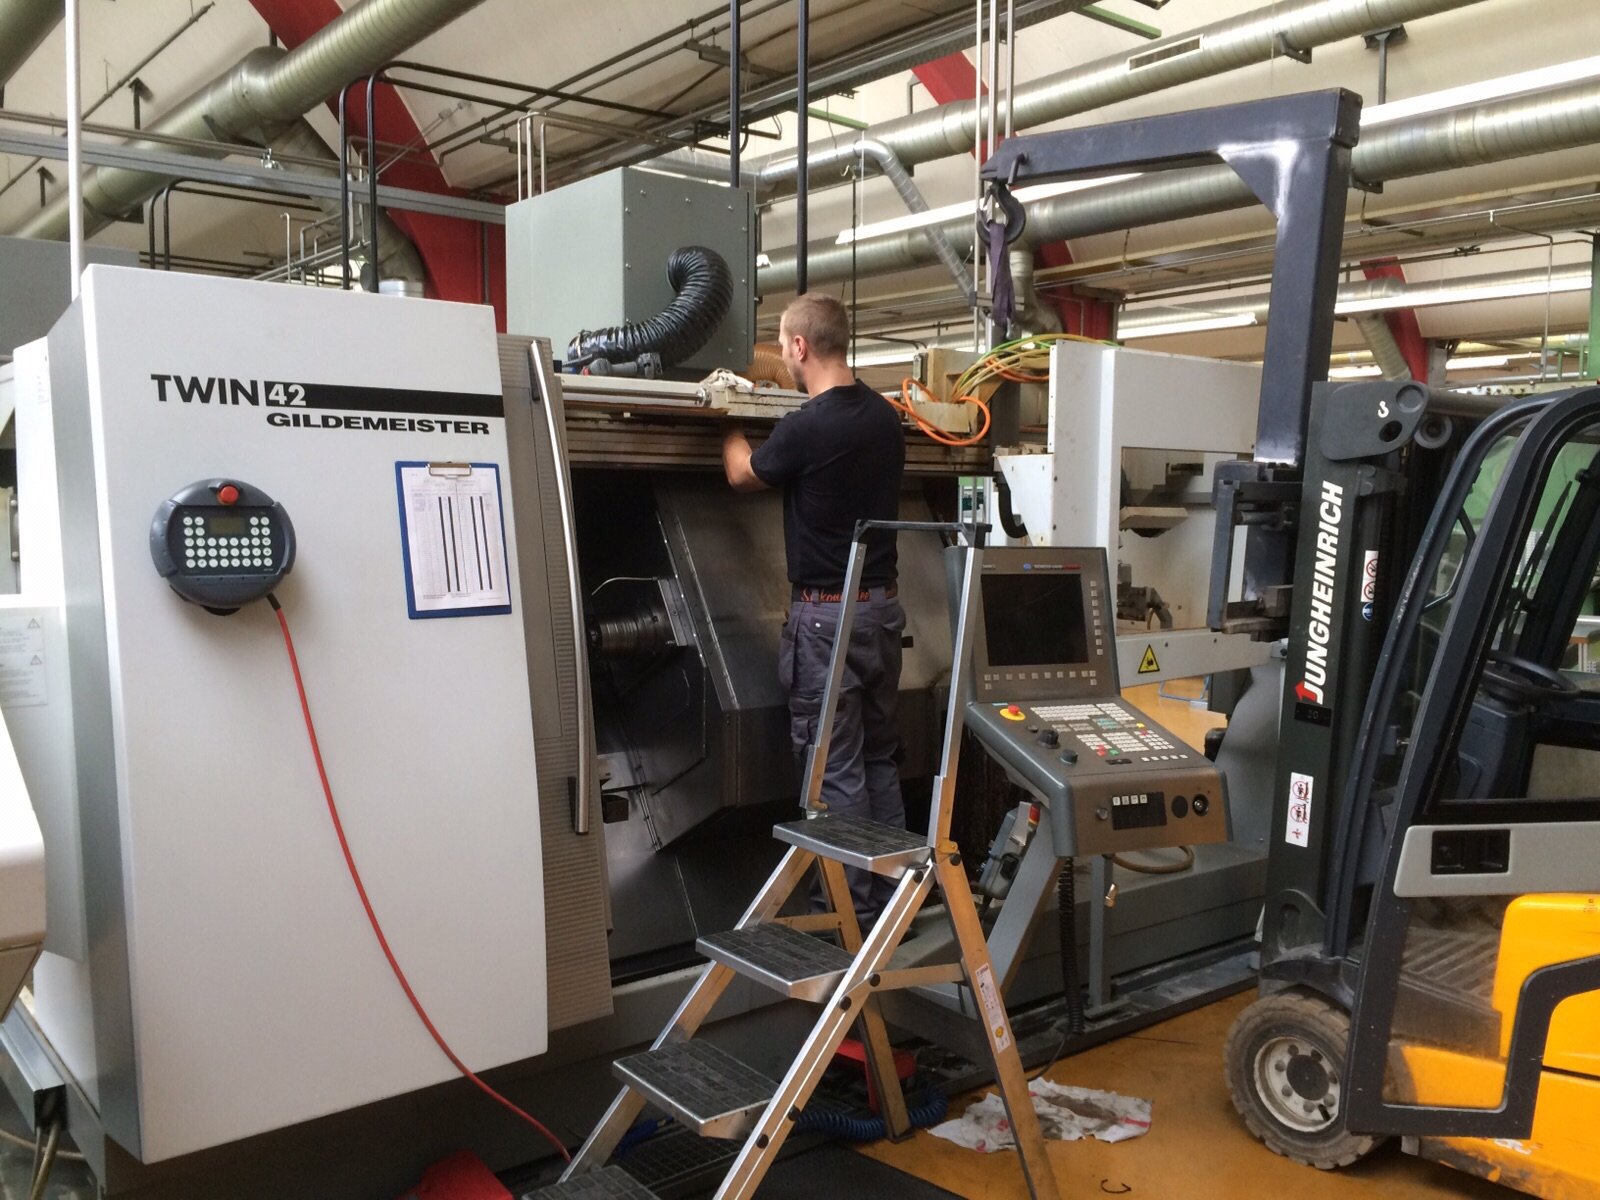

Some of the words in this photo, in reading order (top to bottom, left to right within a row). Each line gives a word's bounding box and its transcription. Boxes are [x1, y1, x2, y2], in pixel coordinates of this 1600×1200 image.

[150, 374, 260, 406] TWIN
[268, 384, 307, 406] 42
[266, 412, 491, 435] GILDEMEISTER
[1296, 480, 1343, 705] JUNGHEINRICH
